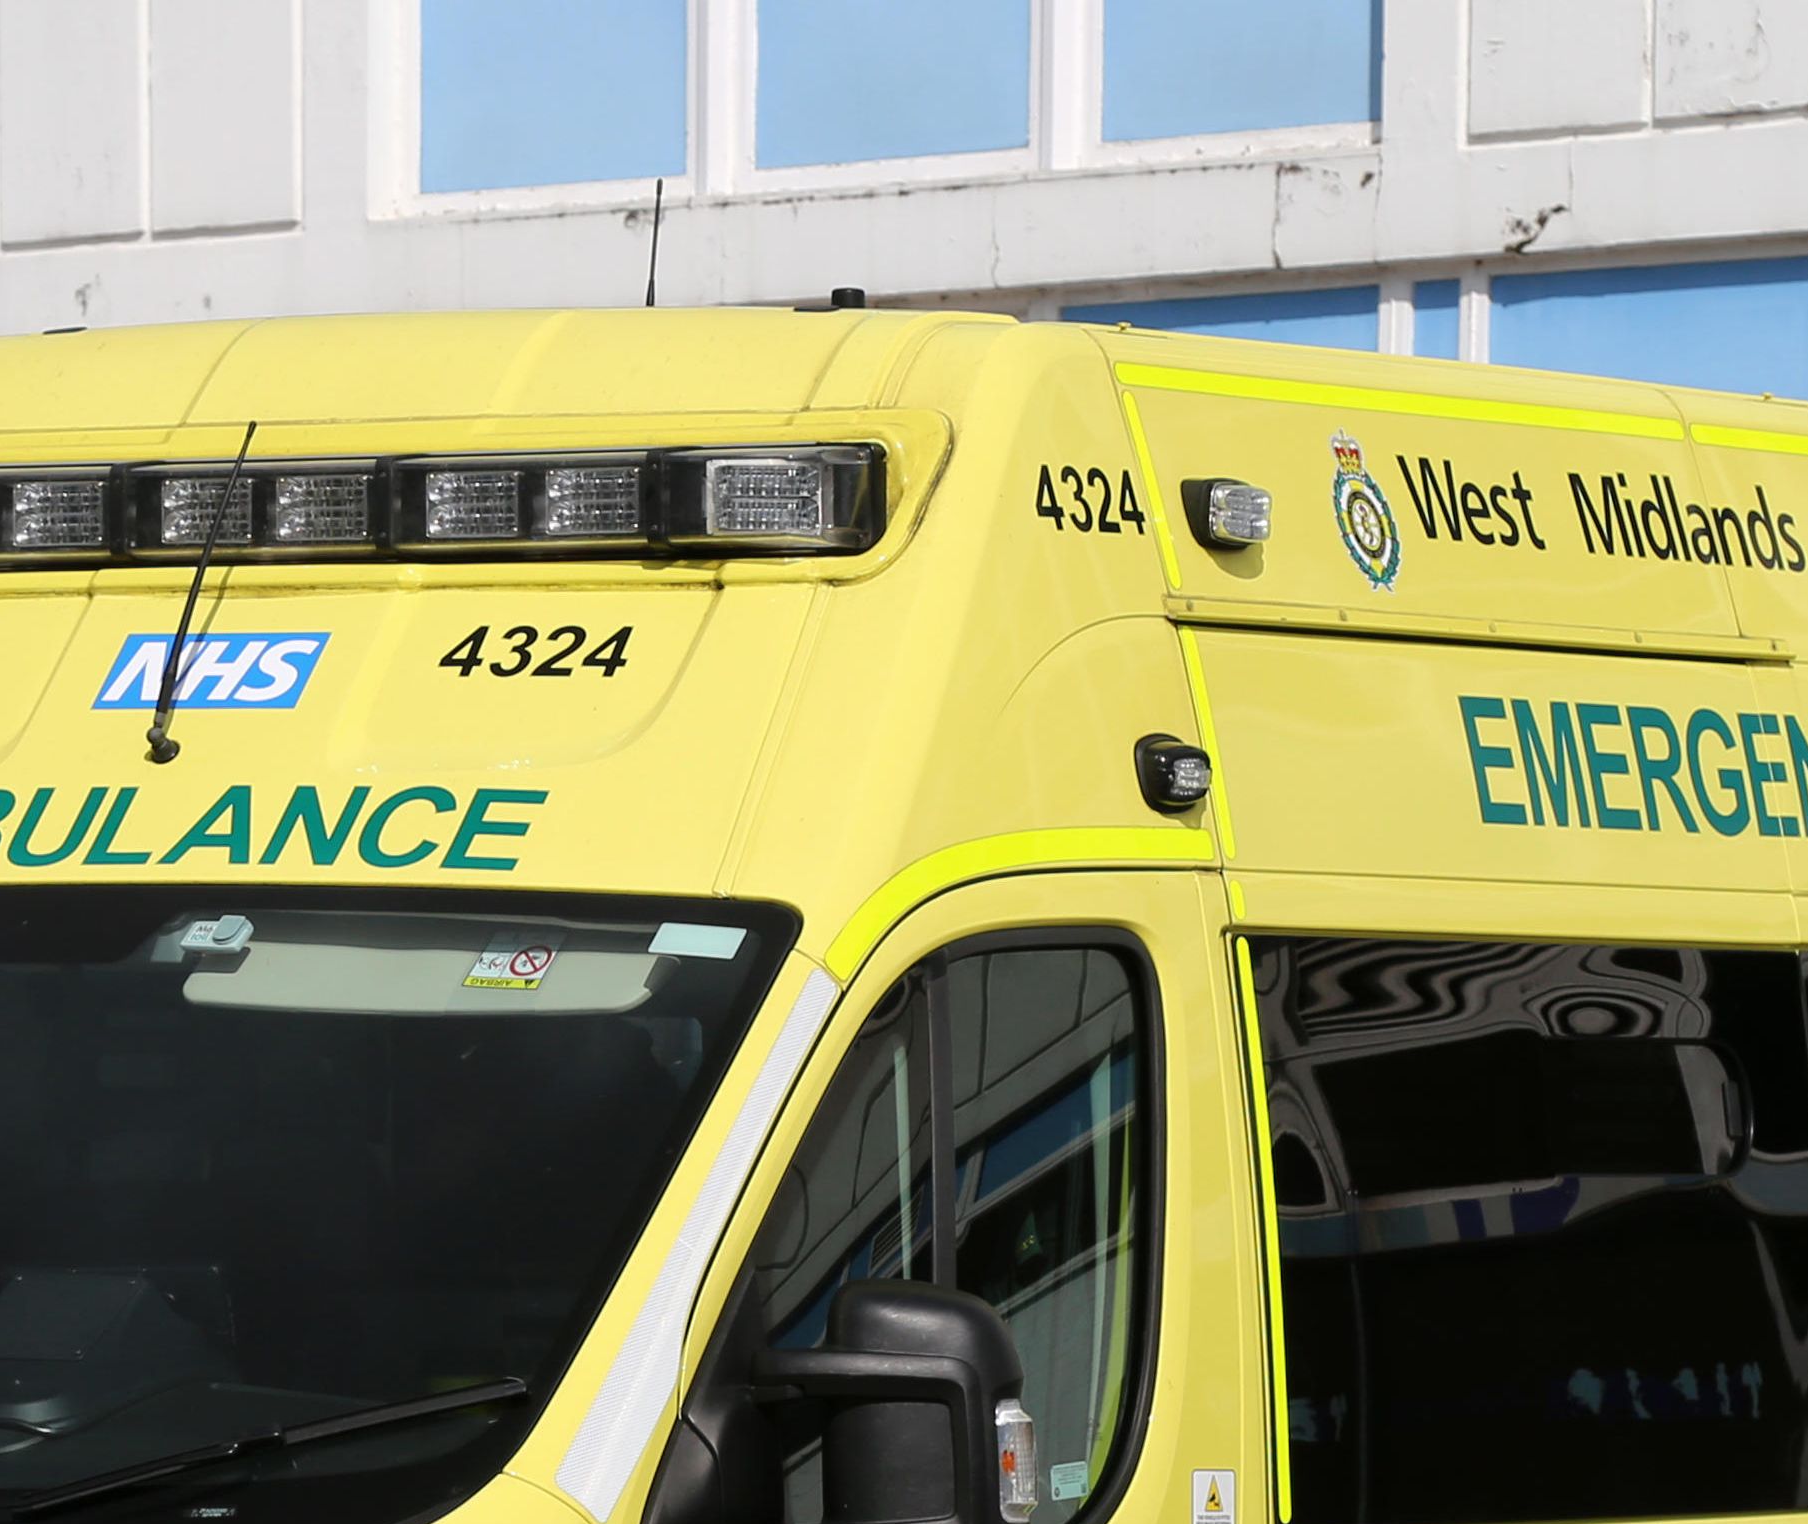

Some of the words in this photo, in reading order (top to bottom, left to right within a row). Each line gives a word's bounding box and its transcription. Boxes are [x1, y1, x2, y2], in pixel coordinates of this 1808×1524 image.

[1036, 464, 1146, 534] 4324
[1396, 455, 1545, 551] West
[1568, 471, 1806, 573] Midlands
[100, 639, 321, 702] NHS
[438, 624, 634, 679] 4324
